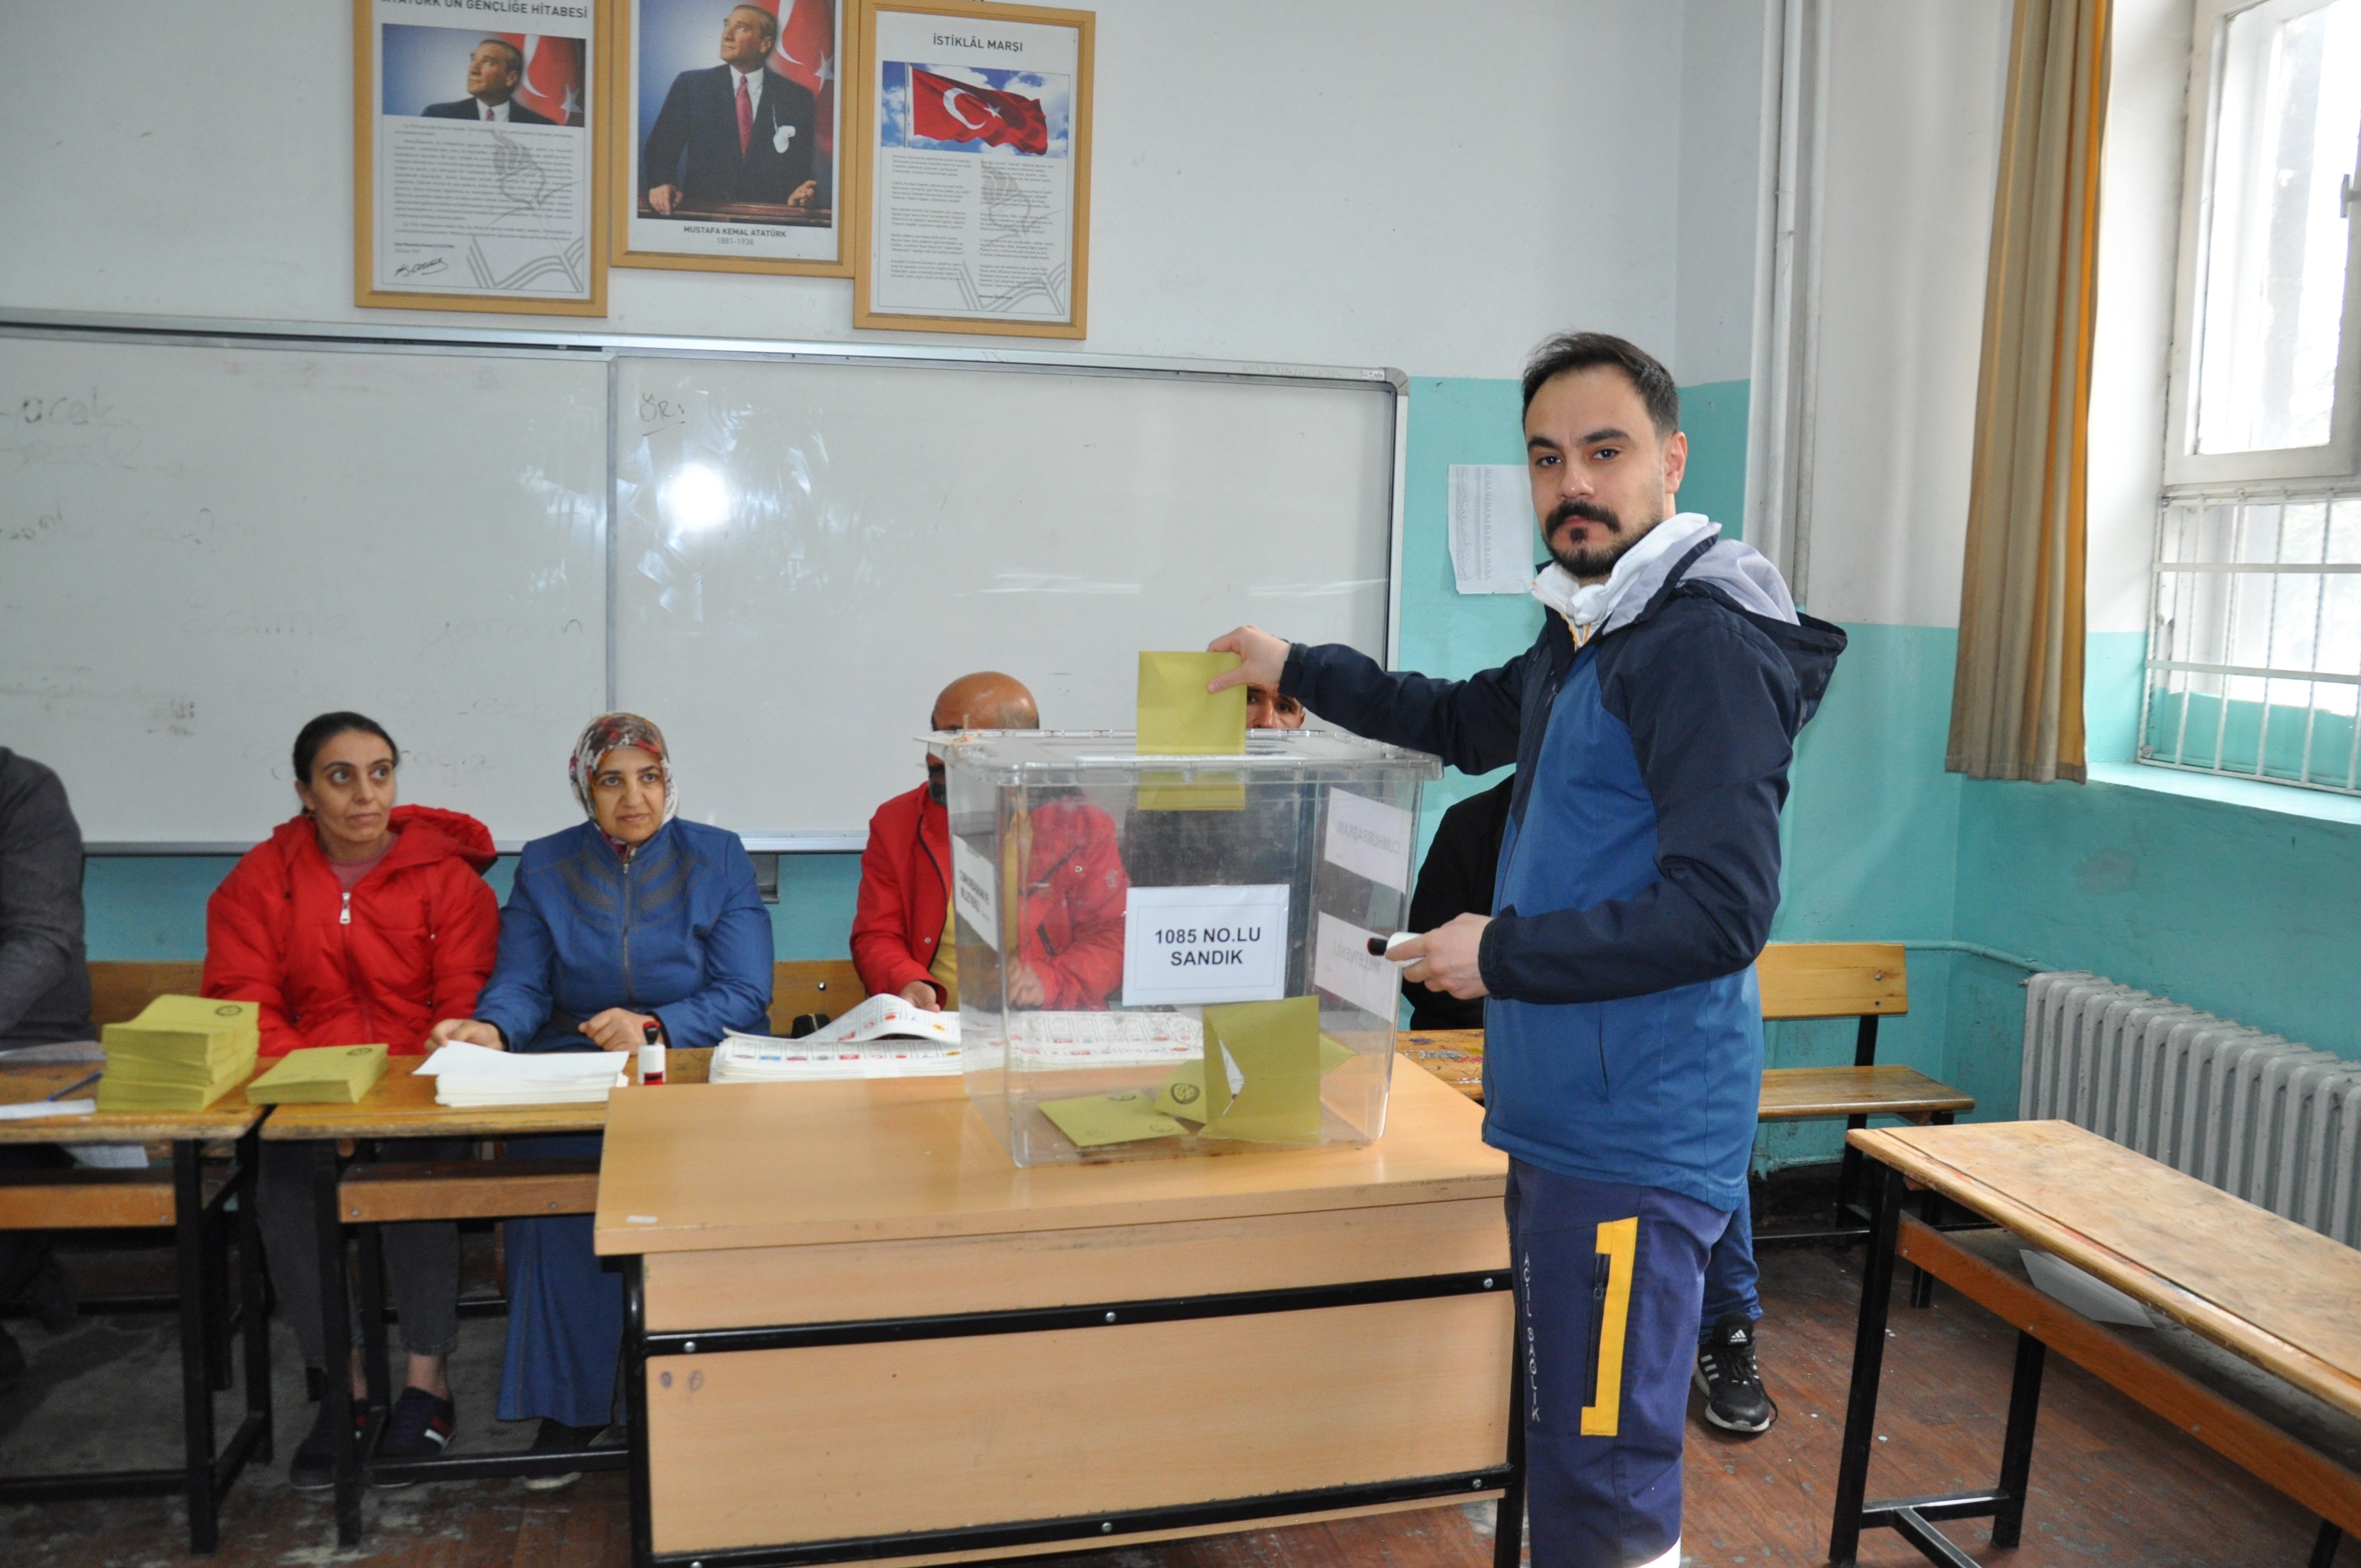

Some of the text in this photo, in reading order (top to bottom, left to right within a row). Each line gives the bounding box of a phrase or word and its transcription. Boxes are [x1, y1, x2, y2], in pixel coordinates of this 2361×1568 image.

[467, 0, 527, 14] GENÇLİĞE
[531, 4, 588, 18] HİTABESİ
[933, 33, 1023, 52] İSTİKLÂL MARŞI
[751, 228, 787, 237] ATATÜRK
[717, 237, 754, 246] 1881-1938
[1155, 927, 1261, 944] 1085 NO.LU
[1171, 949, 1243, 966] SANDIK
